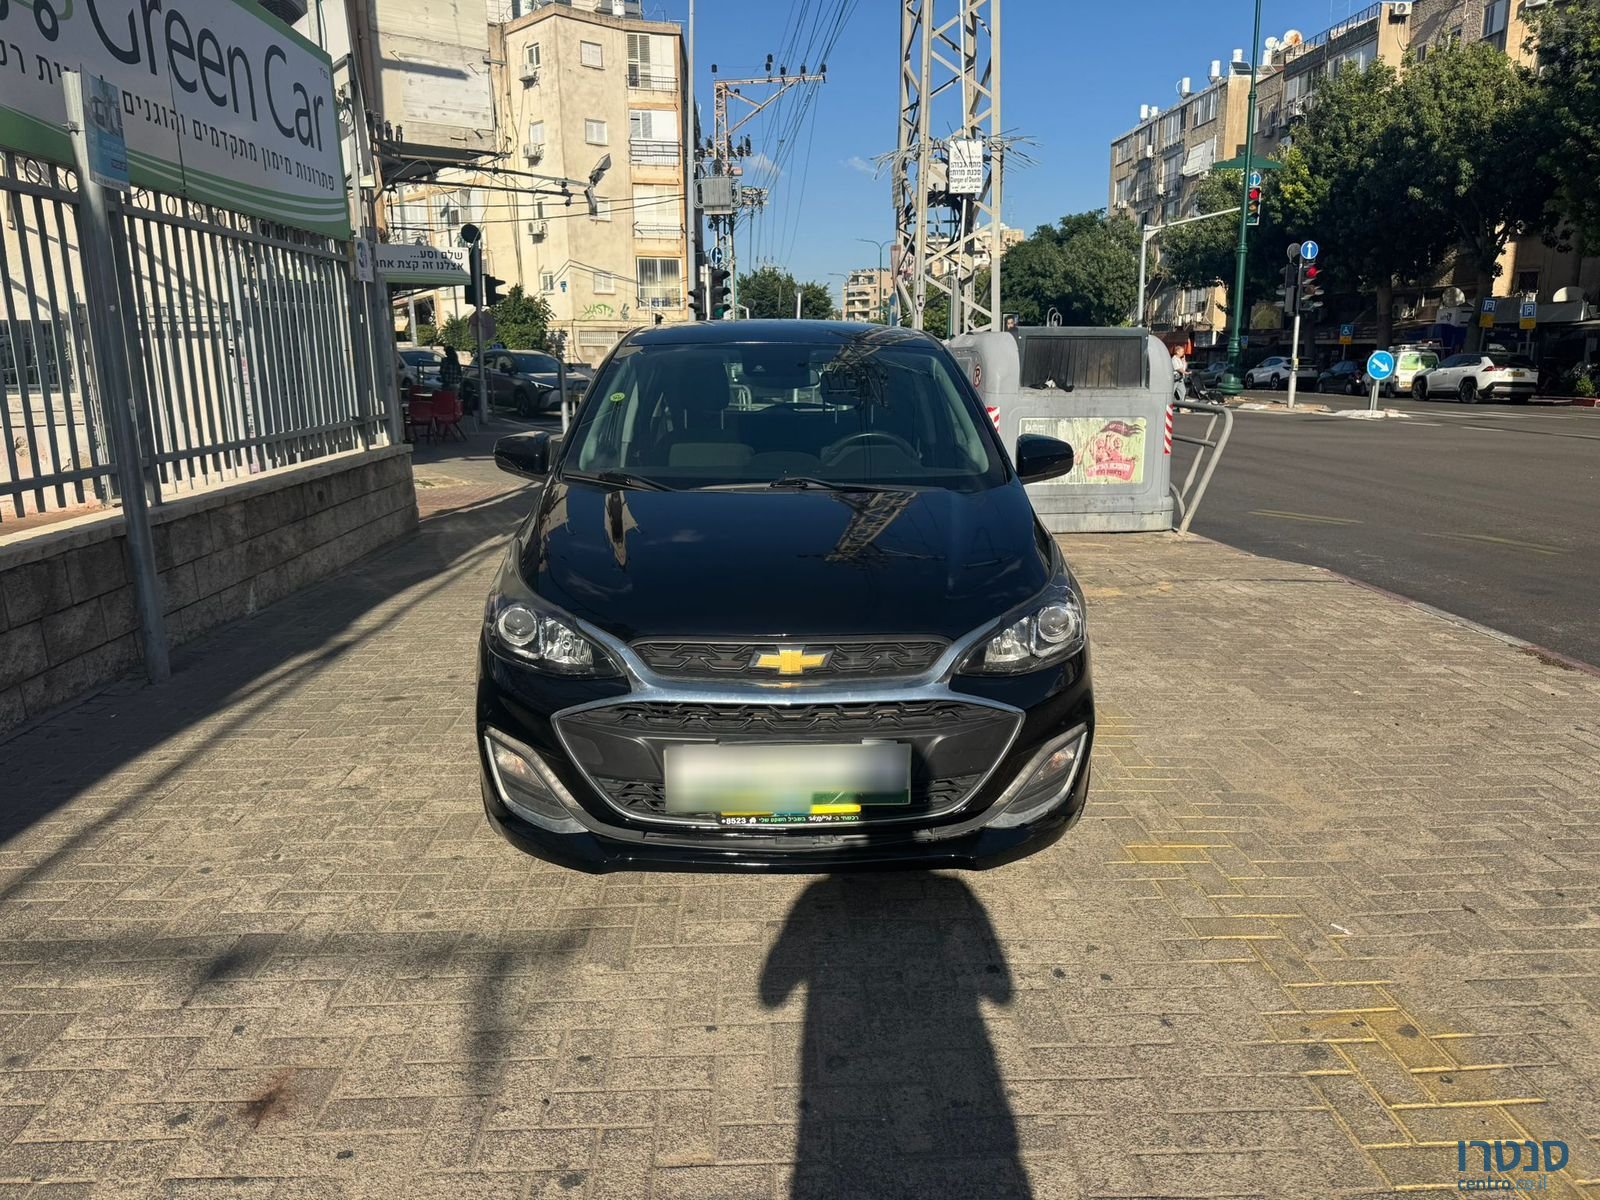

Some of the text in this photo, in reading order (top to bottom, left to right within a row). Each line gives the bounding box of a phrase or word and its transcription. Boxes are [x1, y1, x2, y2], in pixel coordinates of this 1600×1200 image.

[265, 44, 324, 152] Car
[122, 90, 186, 135] והוגנים
[192, 118, 257, 162] מתקדמים
[261, 147, 292, 175] מימון
[296, 161, 334, 191] פתרונות
[397, 260, 419, 271] קצת
[422, 261, 433, 269] זה
[437, 260, 463, 271] אצלנו
[441, 250, 463, 259] שלם
